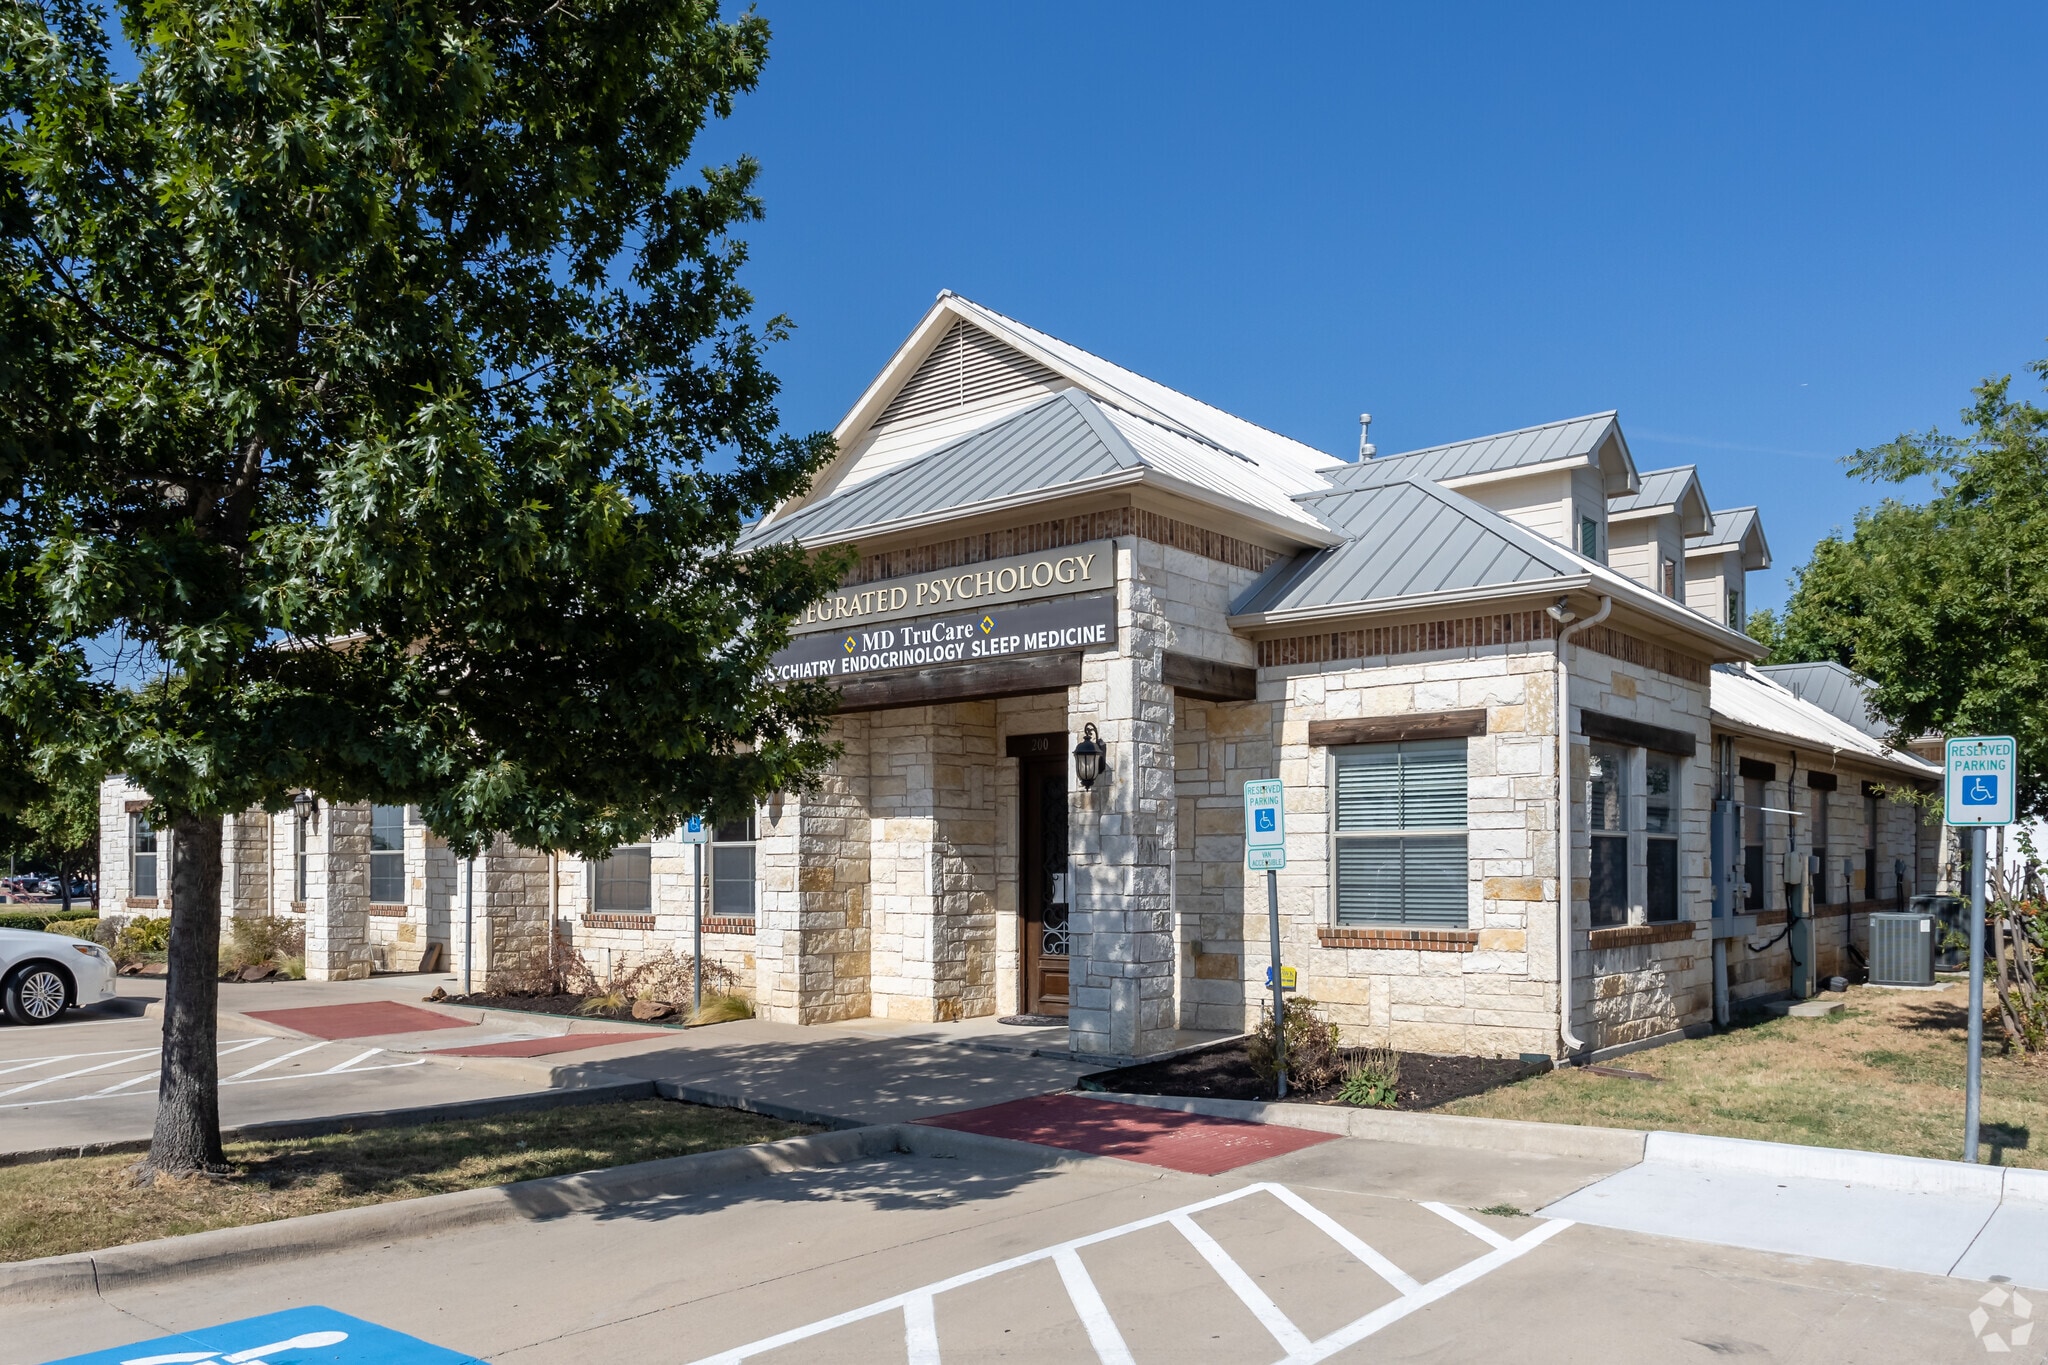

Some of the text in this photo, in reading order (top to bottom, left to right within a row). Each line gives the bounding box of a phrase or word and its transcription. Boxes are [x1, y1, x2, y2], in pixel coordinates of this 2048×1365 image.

[794, 553, 1096, 626] EGRATED PSYCHOLOGY
[862, 621, 974, 652] MD TruCare
[841, 642, 965, 673] ENDOCRINOLOGY
[971, 635, 1020, 657] SLEEP
[1024, 624, 1107, 651] MEDICINE
[1031, 737, 1049, 751] 200
[1952, 744, 2010, 756] RESERVED
[1955, 760, 2005, 771] PARKING
[1248, 785, 1281, 795] RESERVED
[1250, 796, 1279, 806] PARKING
